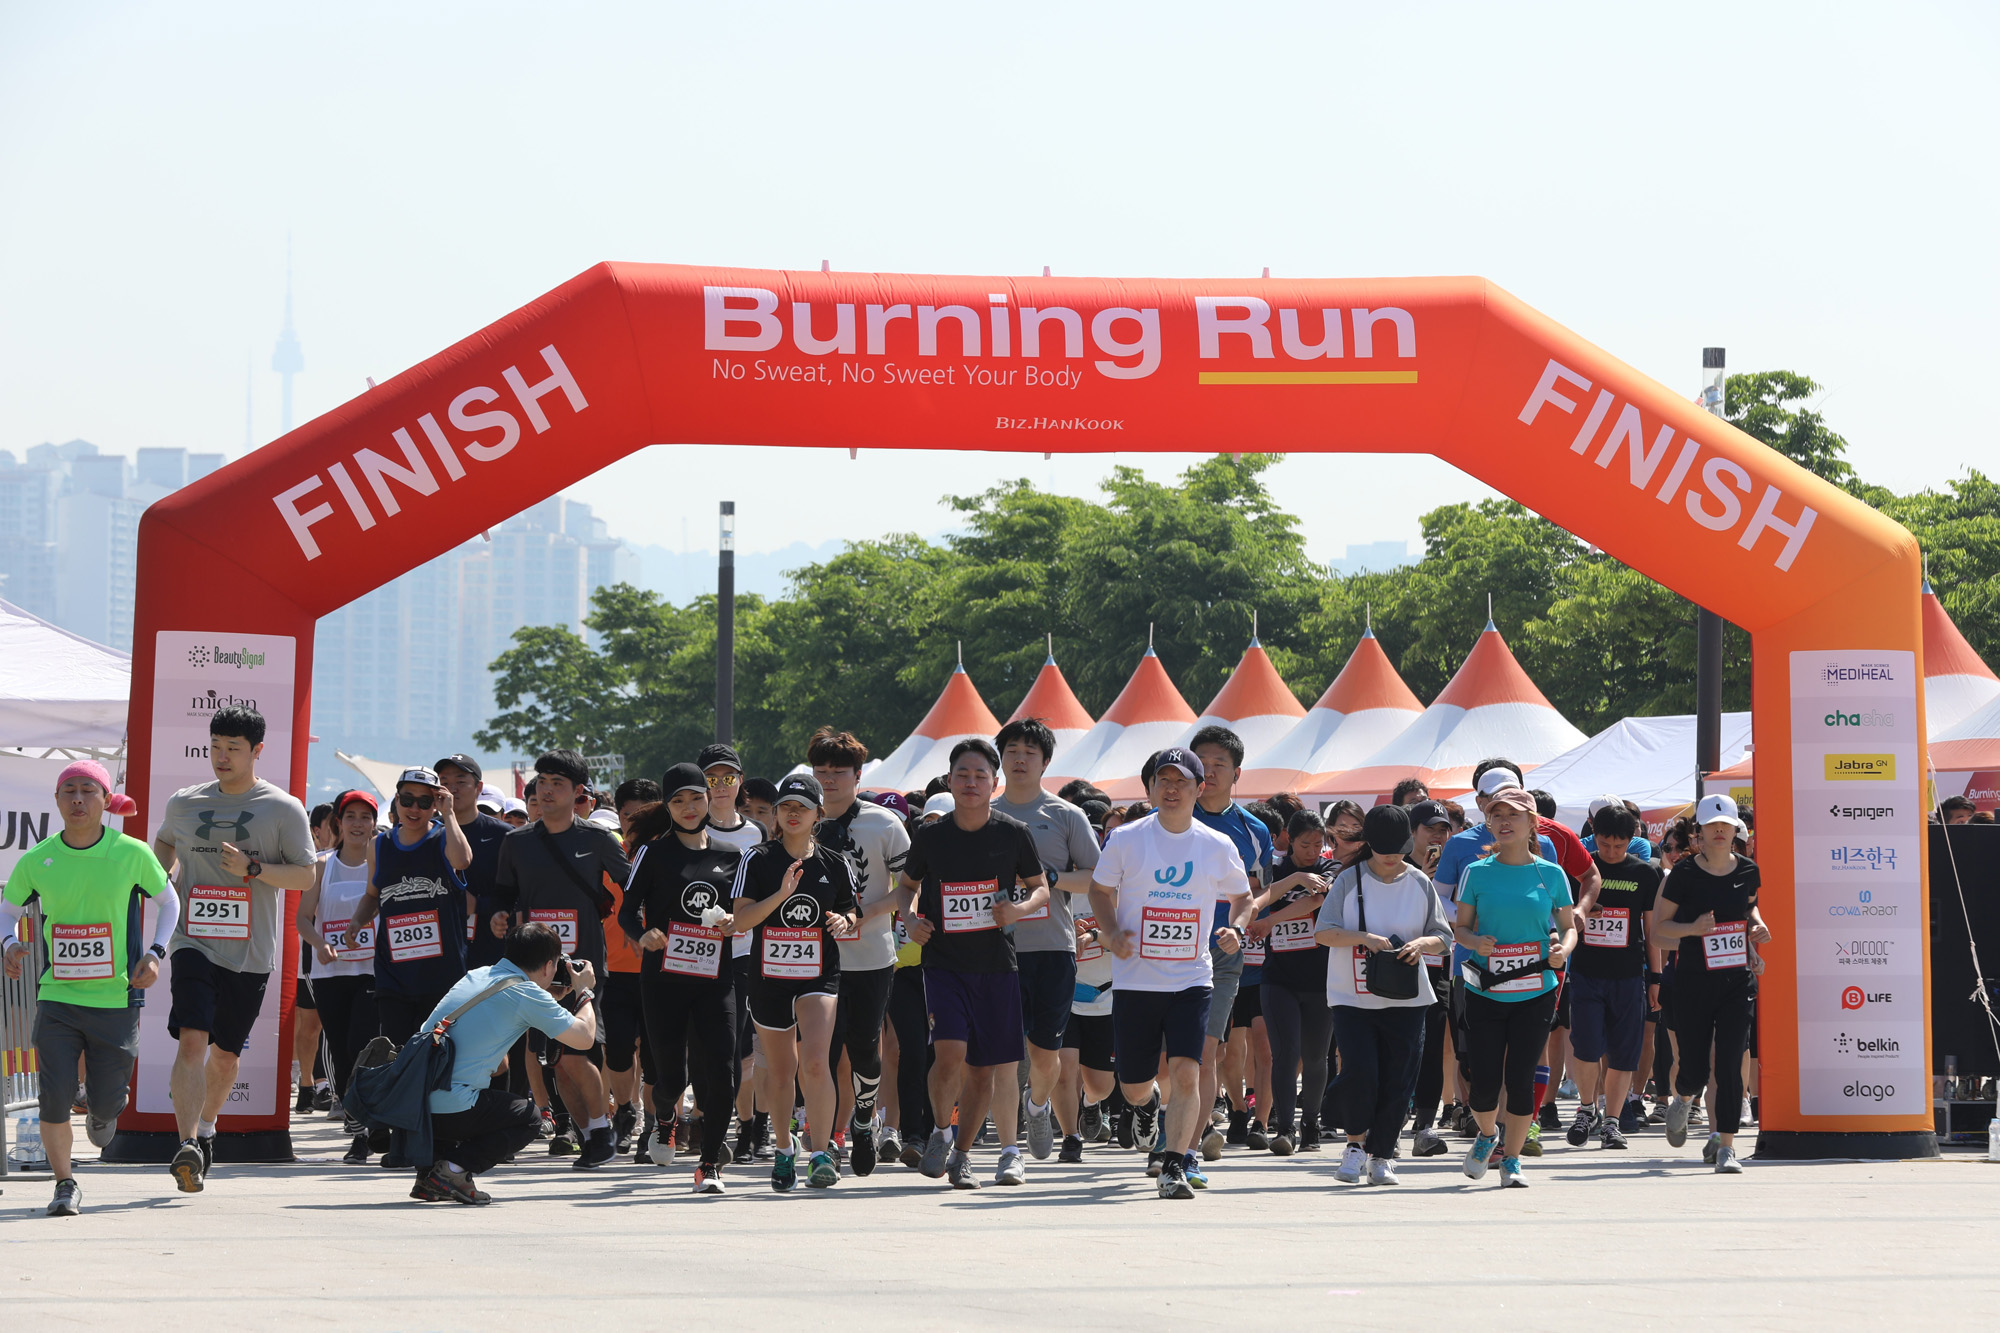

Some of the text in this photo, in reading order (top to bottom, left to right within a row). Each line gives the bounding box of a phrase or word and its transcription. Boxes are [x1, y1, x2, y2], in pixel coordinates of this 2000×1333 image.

[703, 285, 1418, 380] Burning Run
[712, 358, 1083, 390] No Sweat, No Sweet Your Body
[272, 344, 589, 561] FINISH
[1517, 358, 1818, 572] FINISH
[214, 646, 265, 669] BeautySignal
[1827, 668, 1894, 680] MEDIHEAL
[1824, 708, 1894, 727] chacha
[185, 745, 209, 758] Int
[1834, 759, 1888, 770] Jabra GN
[1736, 794, 1753, 805] Jabr
[1842, 807, 1894, 820] spigen
[1830, 846, 1898, 870] 비즈한국
[192, 887, 227, 897] Burning
[944, 884, 977, 892] Burning
[1601, 879, 1639, 892] UNNING
[1148, 890, 1192, 900] PROSPECS
[194, 902, 240, 918] 2951
[949, 896, 993, 912] 2012
[389, 916, 418, 925] Burning
[1146, 909, 1181, 919] Burning
[55, 926, 108, 936] Burning Run
[326, 921, 350, 930] Burnin
[551, 923, 570, 937] 02
[672, 924, 722, 937] Burning Run
[1148, 924, 1193, 940] 2525
[1275, 921, 1309, 936] 2132
[1588, 918, 1624, 932] 3124
[330, 931, 369, 947] 308
[393, 926, 433, 944] 2803
[766, 929, 800, 939] Burning
[58, 941, 105, 958] 2058
[673, 938, 716, 957] 2589
[1492, 946, 1523, 954] Burning
[1710, 935, 1744, 951] 3166
[769, 943, 815, 959] 2734
[1866, 993, 1892, 1003] LIFE
[1857, 1037, 1900, 1051] belkin
[1843, 1080, 1895, 1101] elago
